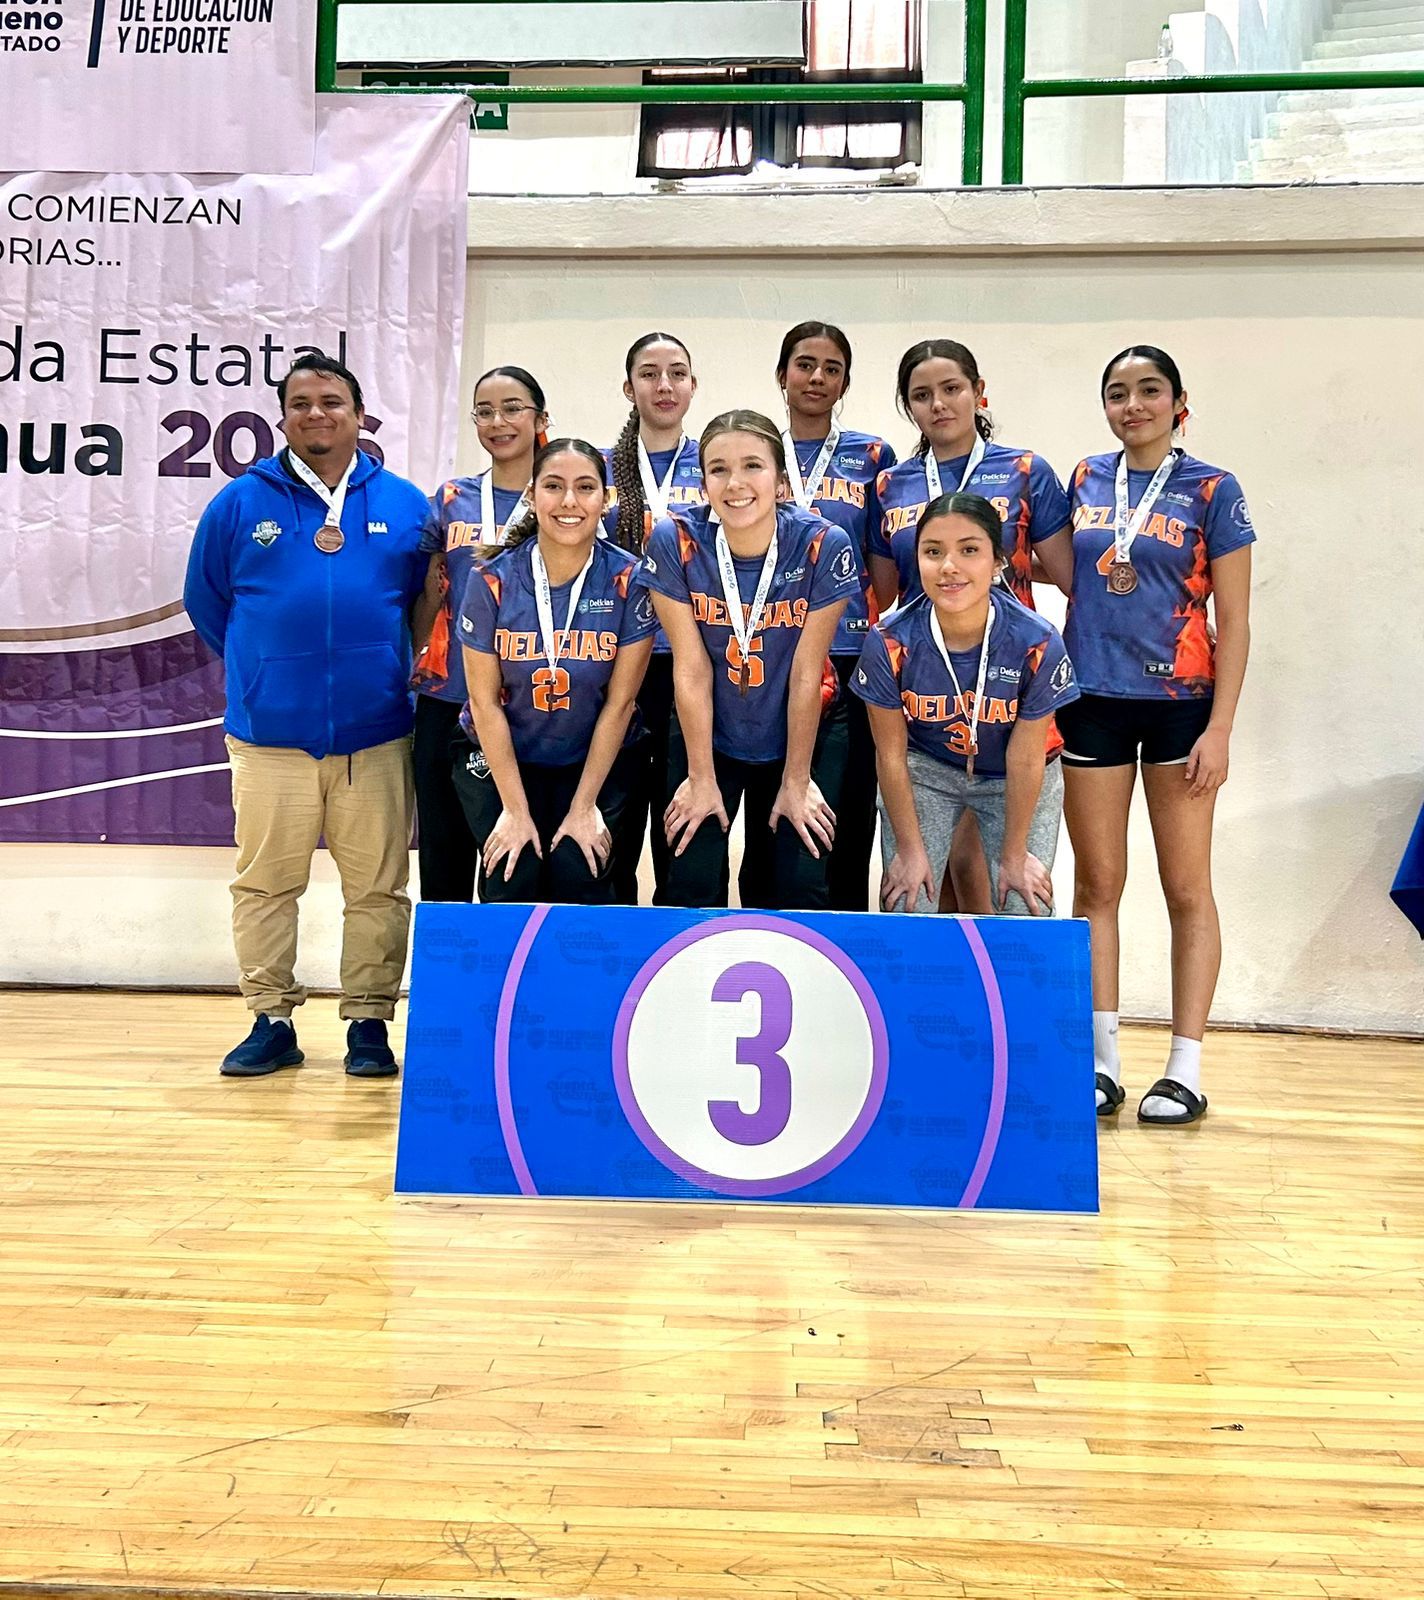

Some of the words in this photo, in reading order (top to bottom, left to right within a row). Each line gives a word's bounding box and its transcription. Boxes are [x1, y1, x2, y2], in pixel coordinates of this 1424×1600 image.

[0, 11, 63, 30] eno
[120, 0, 146, 22] DE
[0, 35, 61, 52] TADO
[117, 26, 131, 54] Y
[135, 26, 231, 54] DEPORTE
[8, 193, 241, 225] COMIENZAN
[0, 237, 121, 266] RIAS...
[100, 328, 347, 388] Estatl
[158, 410, 385, 478] 20
[1072, 504, 1187, 548] DELIAS
[494, 628, 618, 662] DELCIAS
[726, 635, 765, 687] 5
[531, 667, 570, 712] 2
[943, 720, 979, 755] 3
[708, 961, 793, 1146] 3
